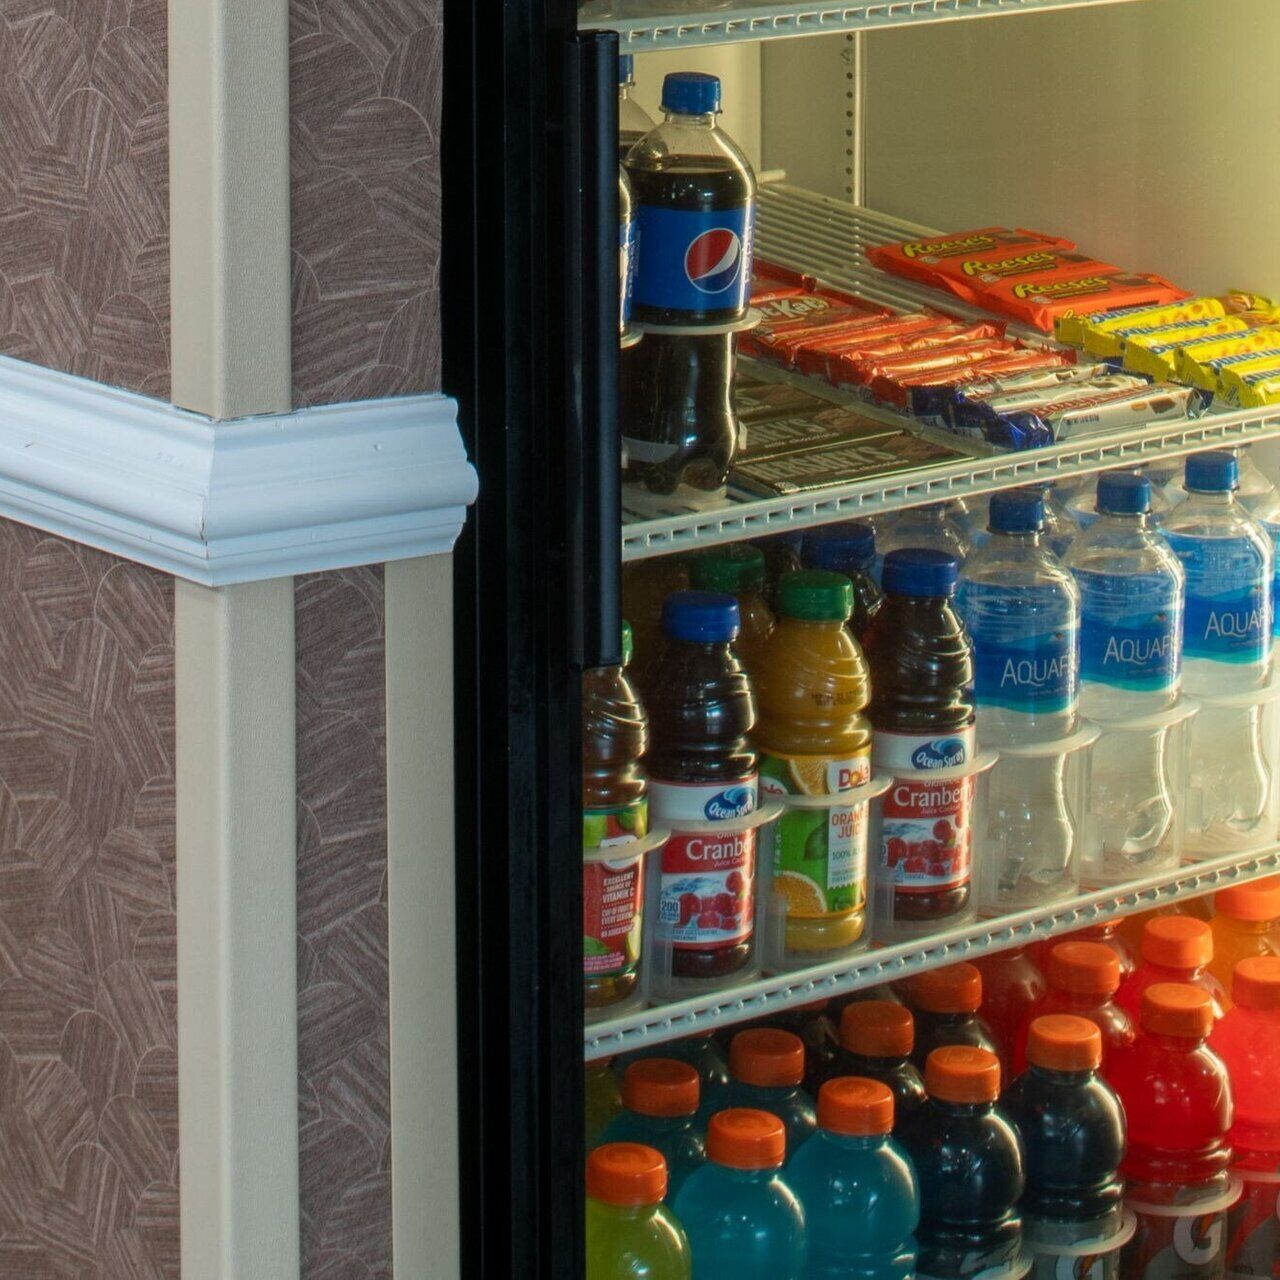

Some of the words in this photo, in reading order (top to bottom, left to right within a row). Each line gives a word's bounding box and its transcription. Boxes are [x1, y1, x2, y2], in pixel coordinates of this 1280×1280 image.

[915, 751, 943, 769] Ocean
[943, 746, 964, 768] Spray
[708, 801, 736, 819] Ocean
[661, 901, 679, 913] 200
